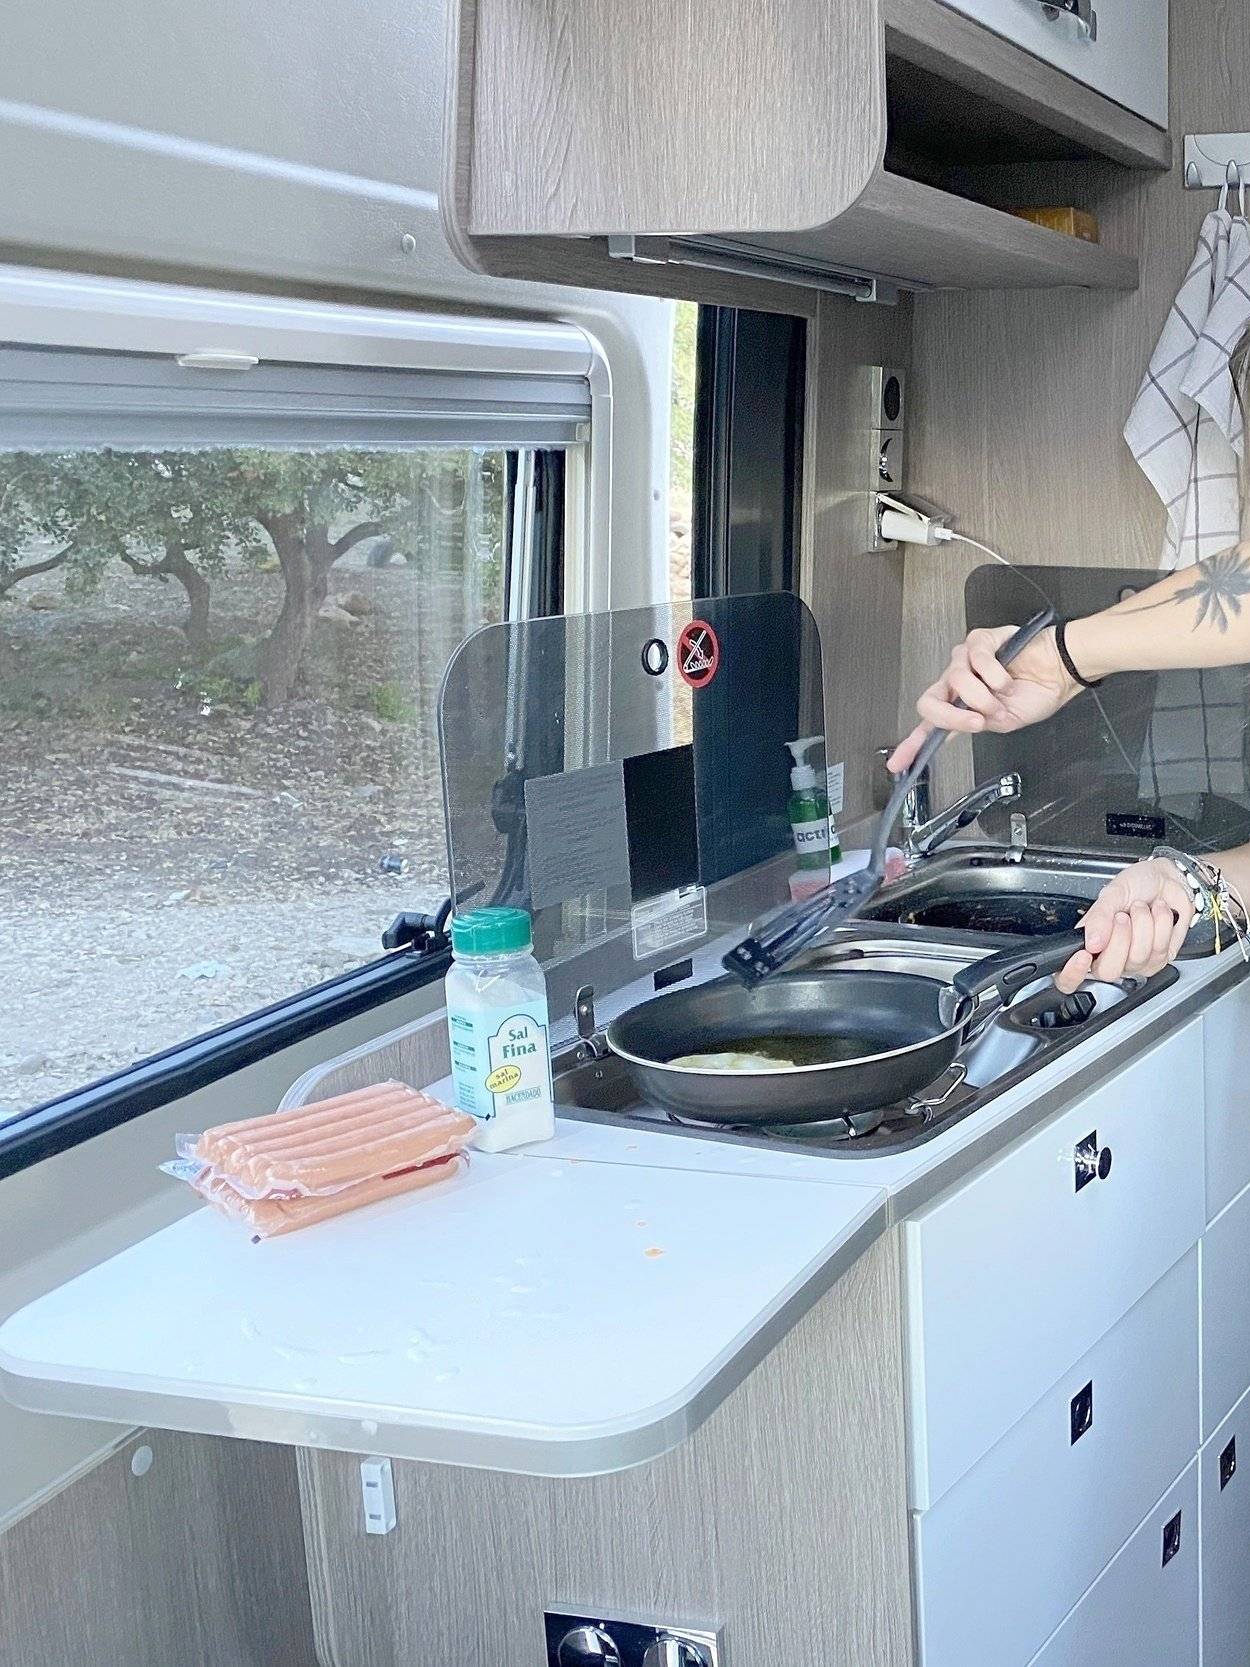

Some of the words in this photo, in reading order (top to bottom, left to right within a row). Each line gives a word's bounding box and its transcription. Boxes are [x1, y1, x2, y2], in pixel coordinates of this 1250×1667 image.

[508, 1026, 528, 1041] Sal
[502, 1042, 537, 1059] Fina
[489, 1072, 519, 1090] marina
[495, 1068, 509, 1079] sal
